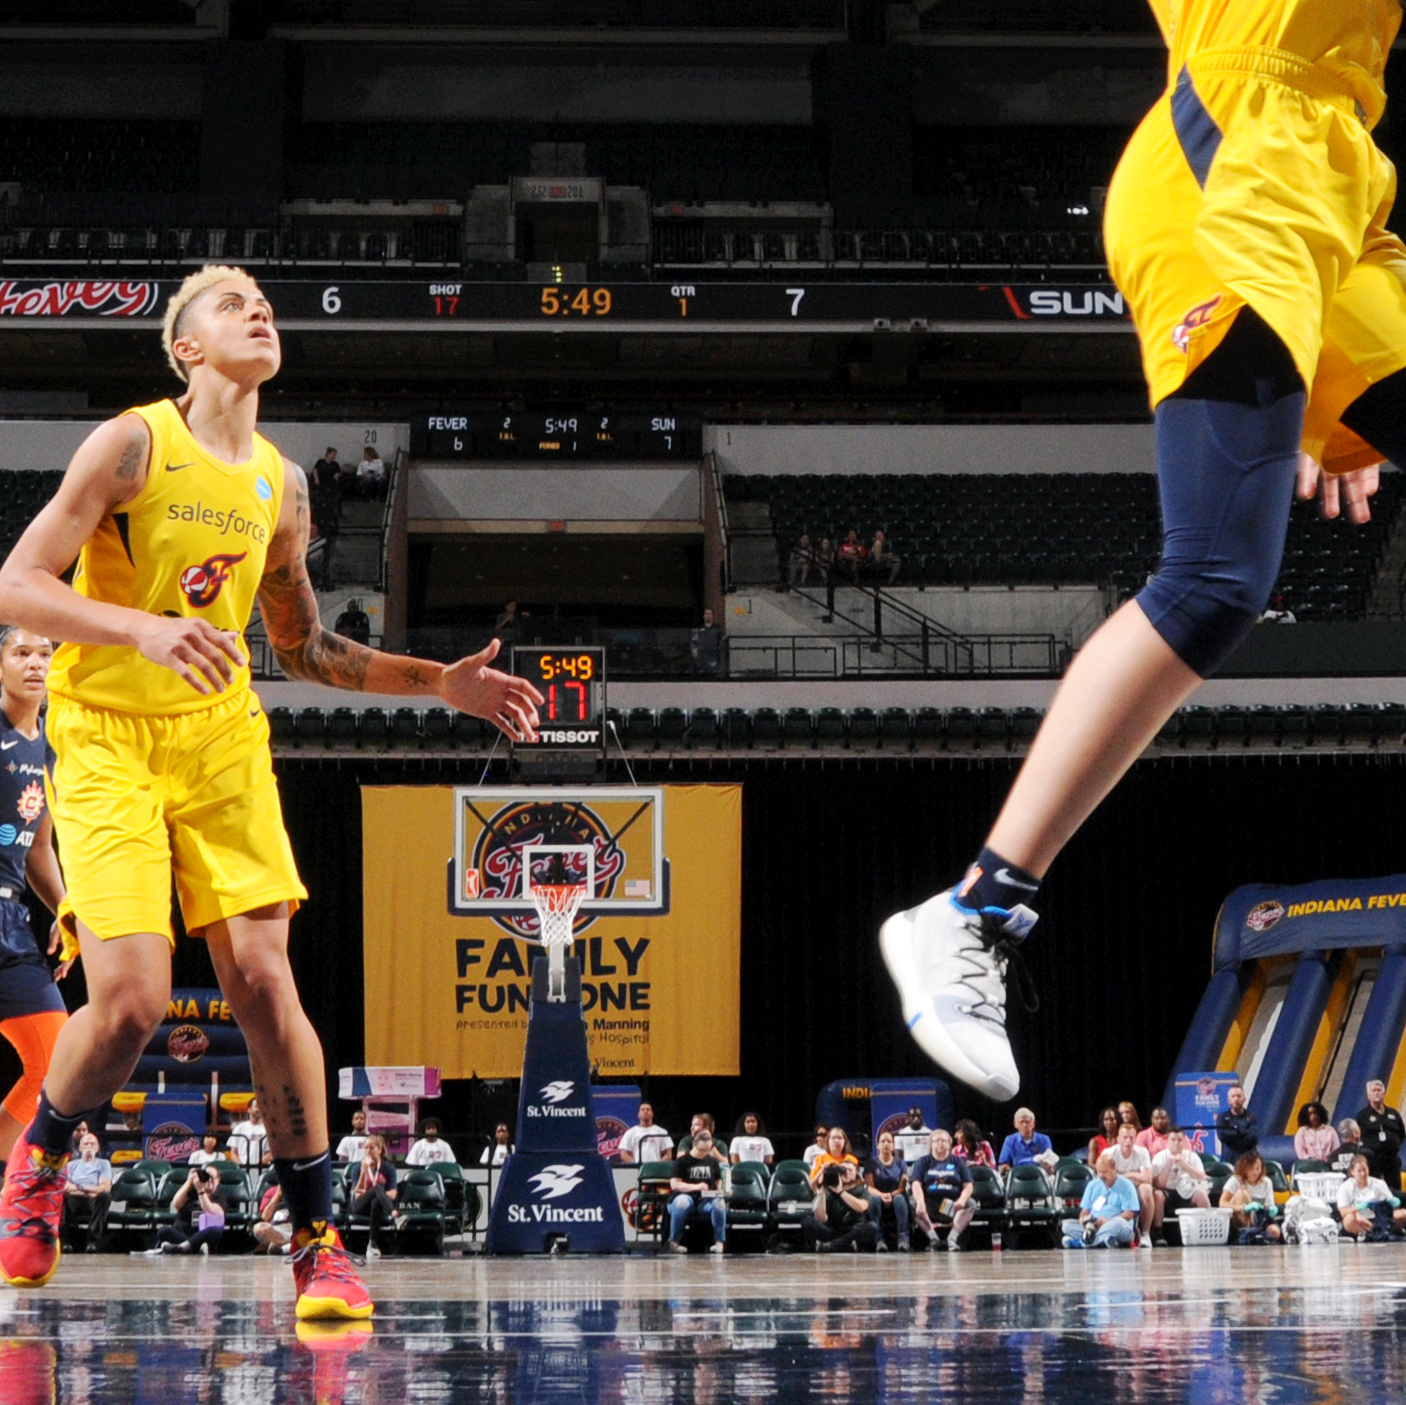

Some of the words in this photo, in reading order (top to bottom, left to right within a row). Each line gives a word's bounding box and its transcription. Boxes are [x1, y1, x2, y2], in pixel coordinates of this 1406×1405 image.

[429, 284, 462, 295] SHOT
[671, 286, 695, 296] QTR
[321, 287, 341, 314] 6
[433, 297, 458, 316] 17
[540, 288, 611, 316] 5:49
[679, 298, 688, 317] 1
[786, 288, 805, 316] 7
[1029, 291, 1123, 315] SUN
[428, 418, 467, 430] FEVER
[504, 418, 510, 428] 2
[545, 418, 577, 432] 5:49
[601, 418, 608, 428] 2
[652, 418, 675, 430] SUN
[454, 437, 462, 450] 6
[664, 436, 671, 450] 7
[167, 501, 265, 544] salesforce
[540, 655, 592, 680] 5:49
[548, 681, 586, 721] 17
[540, 731, 599, 743] TISSOT
[1287, 897, 1362, 917] INDIANA
[456, 983, 531, 1013] FUN
[582, 982, 651, 1012] ONE
[456, 1020, 517, 1030] presented
[593, 1019, 650, 1031] Manning
[600, 1033, 650, 1046] Hospital
[595, 1058, 634, 1068] Vincent
